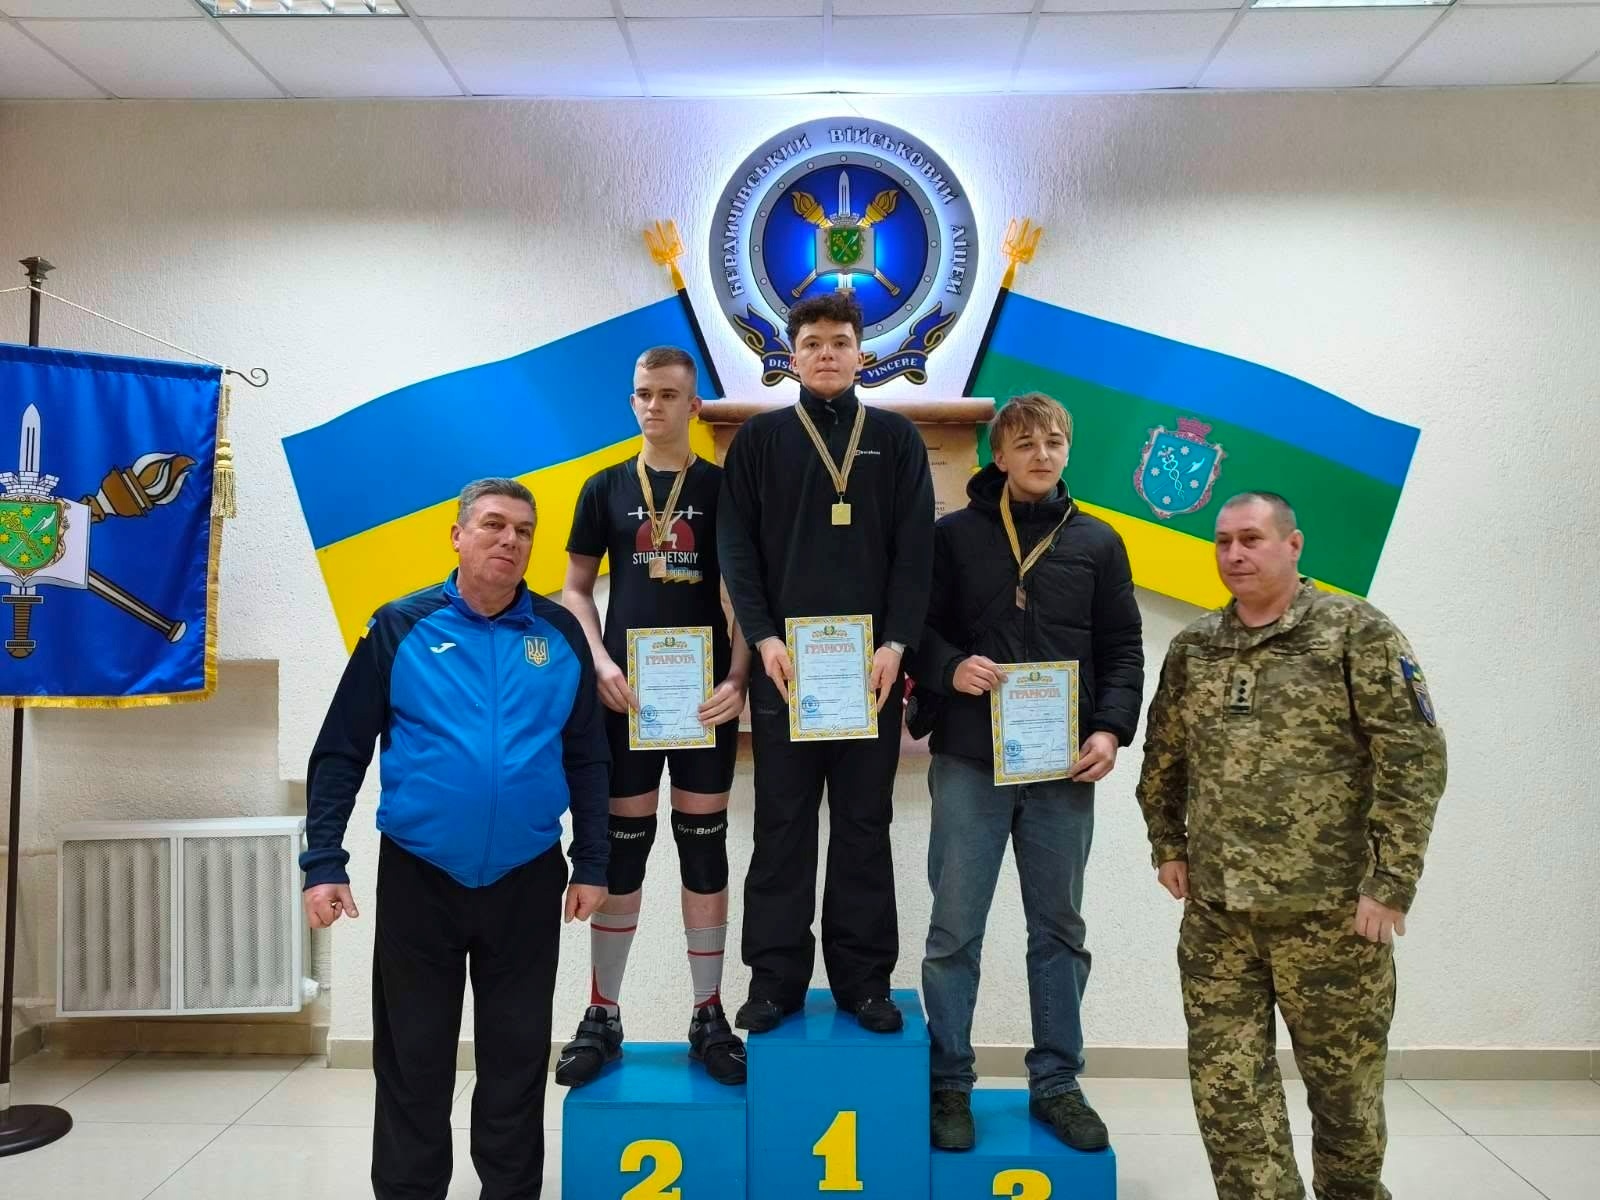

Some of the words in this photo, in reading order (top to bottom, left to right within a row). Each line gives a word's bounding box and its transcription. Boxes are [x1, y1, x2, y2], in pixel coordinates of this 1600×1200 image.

[724, 133, 812, 298] БЕРДИЧІВСЬКИЙ
[829, 126, 960, 205] ВІЙСЬКОВИЙ
[945, 224, 969, 296] ЛІЦЕЙ
[866, 357, 918, 378] VINCERE
[620, 1139, 683, 1200] 2
[813, 1111, 863, 1191] 1
